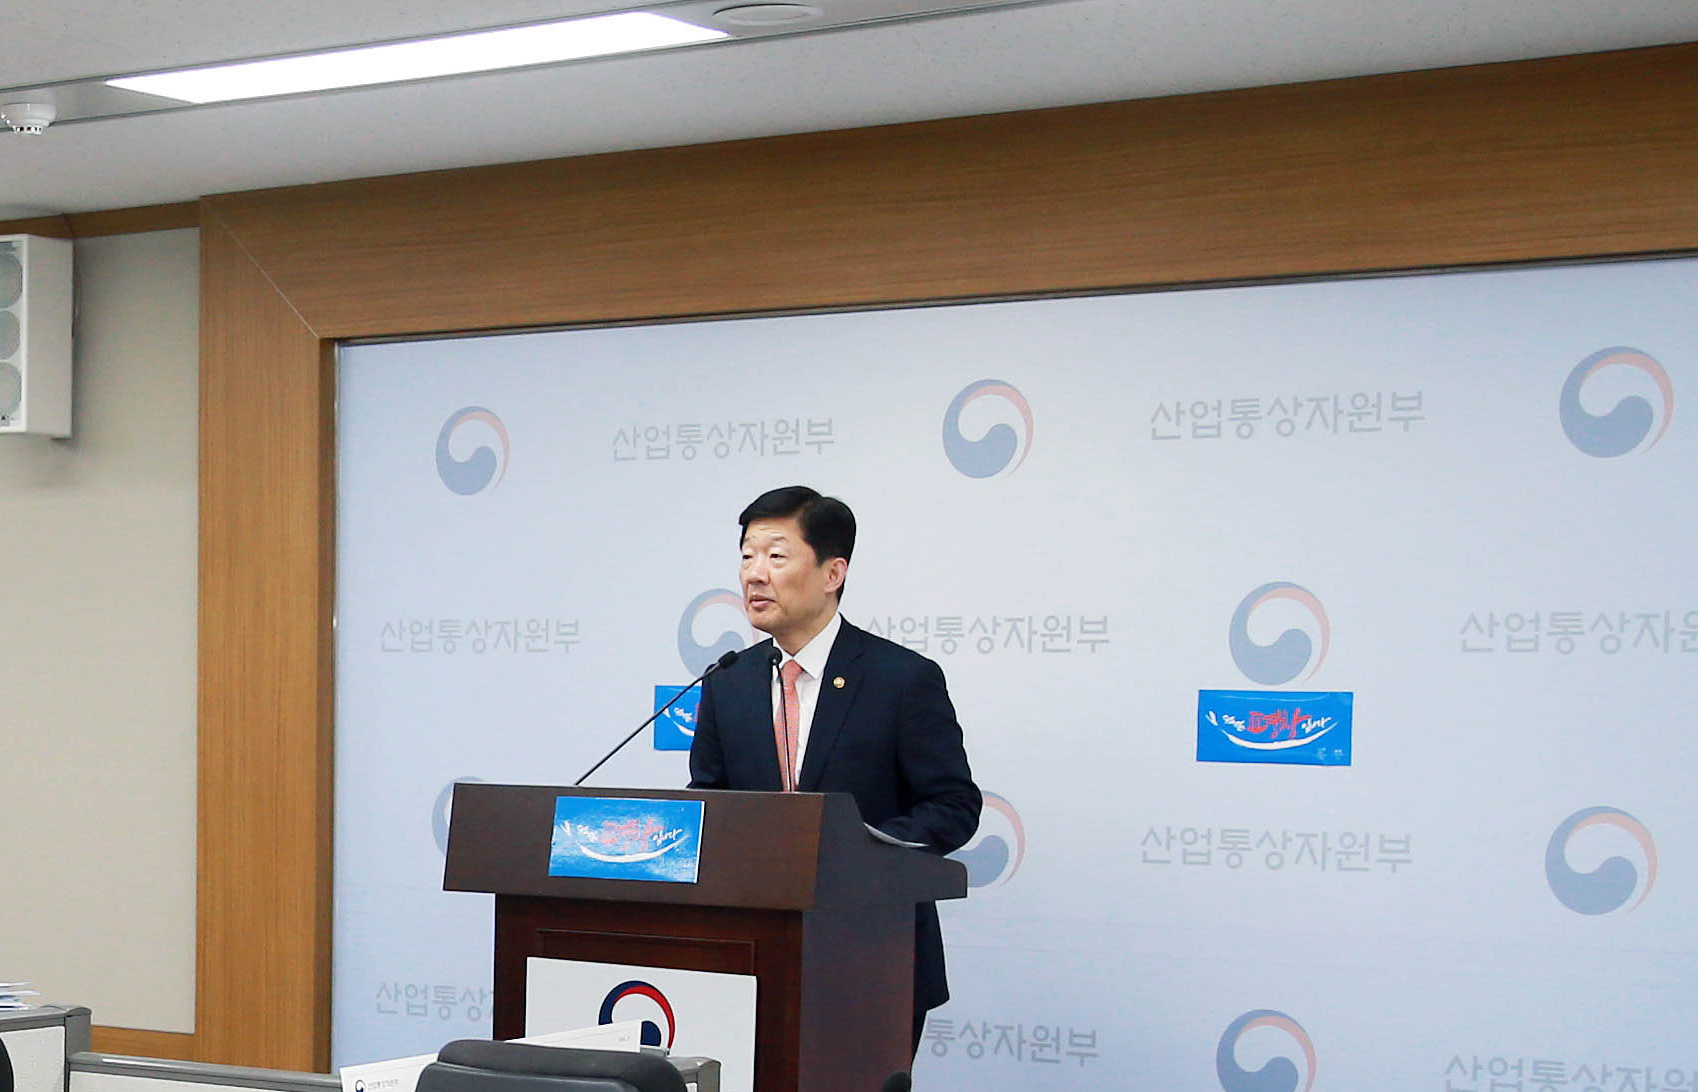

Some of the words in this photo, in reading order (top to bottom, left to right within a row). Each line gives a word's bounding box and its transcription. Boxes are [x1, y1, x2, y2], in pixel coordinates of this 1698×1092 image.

[1150, 390, 1426, 441] 산업통상자원부
[612, 418, 835, 462] 산업통상자원부
[381, 618, 582, 655] 산업통상자원부
[1141, 825, 1413, 874] 산업통상자원부
[375, 981, 493, 1021] 산업통상
